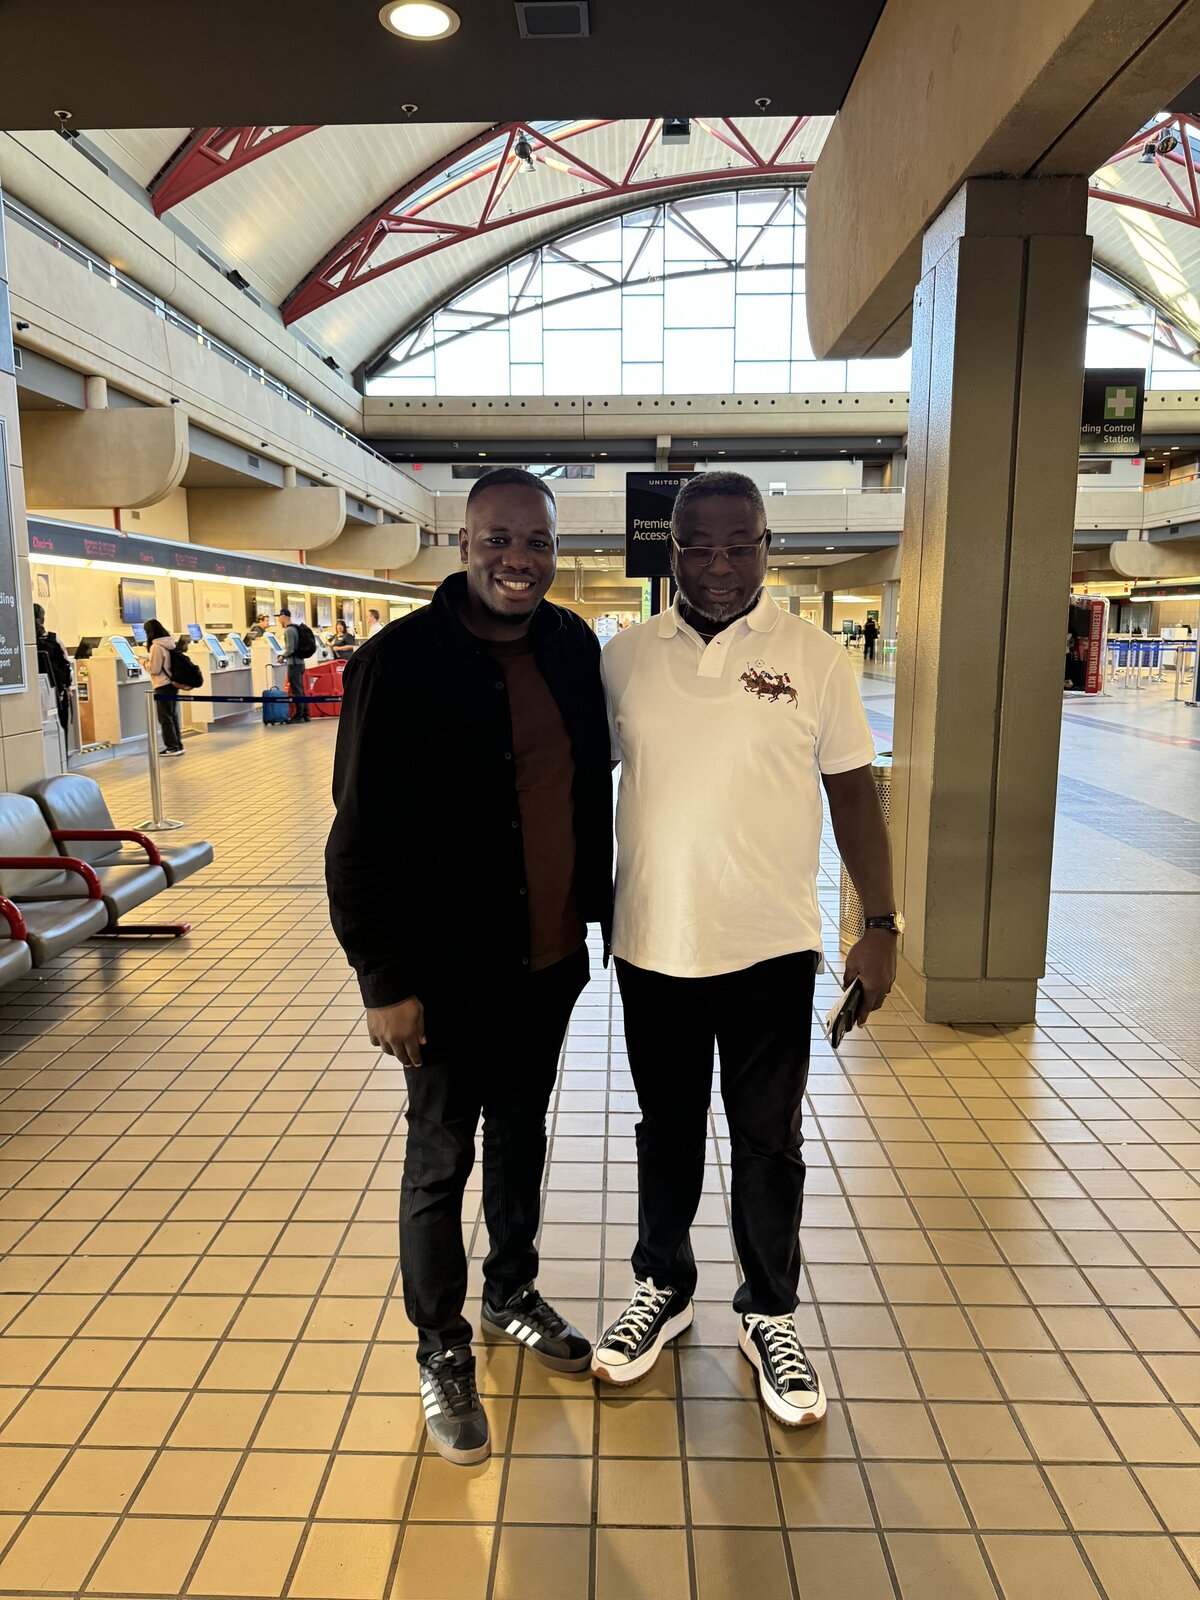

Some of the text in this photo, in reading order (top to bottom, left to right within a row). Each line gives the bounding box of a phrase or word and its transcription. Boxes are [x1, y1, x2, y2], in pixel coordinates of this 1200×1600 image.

[1081, 423, 1136, 434] ding Control
[1103, 435, 1135, 443] Station
[633, 518, 673, 529] Premier
[633, 531, 667, 541] Access
[13, 645, 20, 655] of
[1087, 605, 1102, 689] BLEEDING CONTROL KIT
